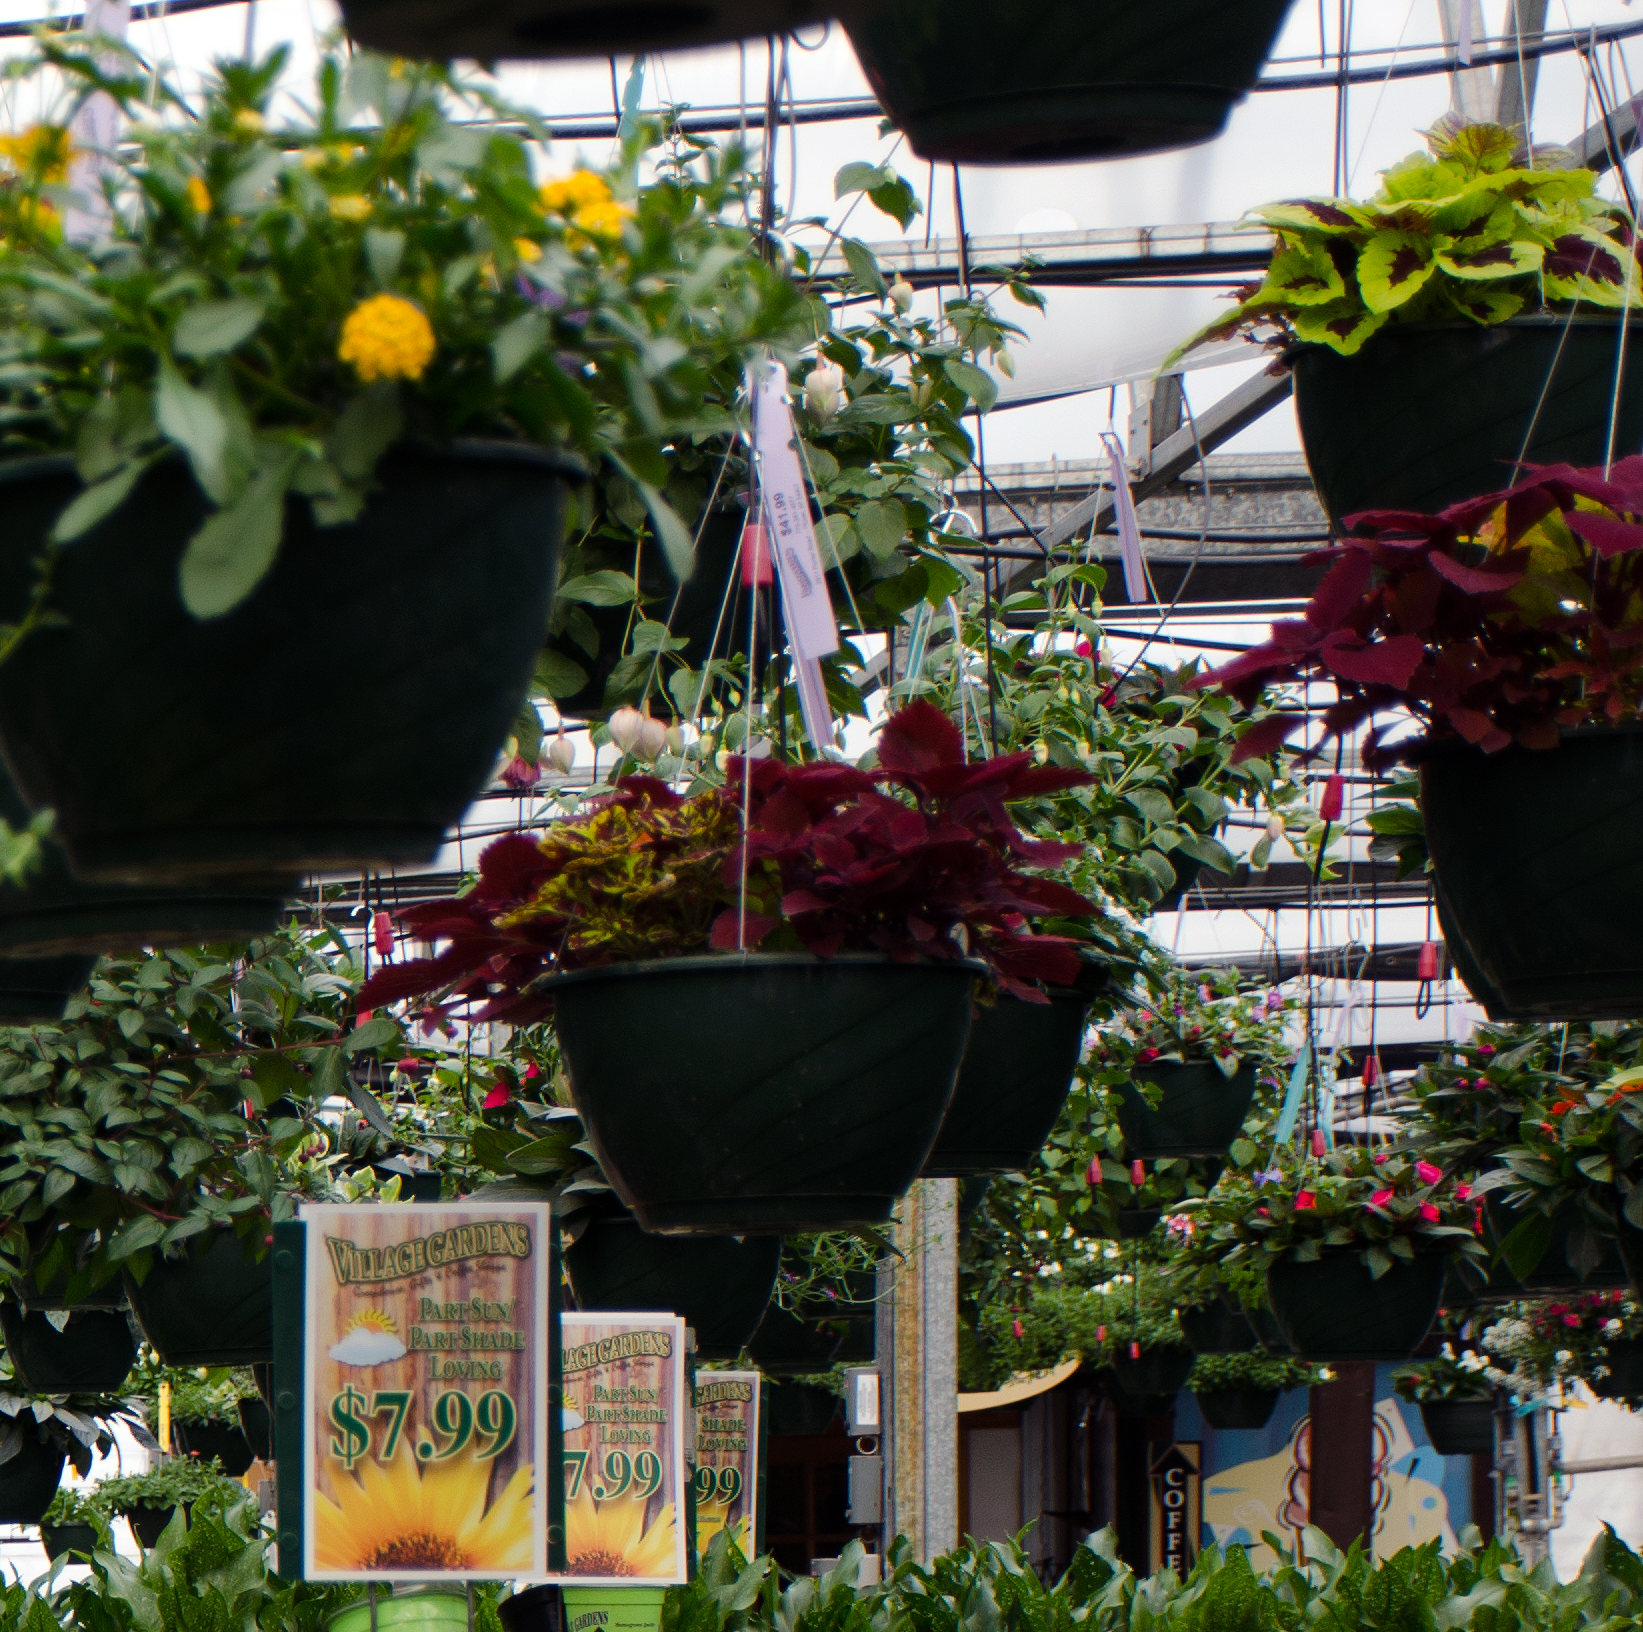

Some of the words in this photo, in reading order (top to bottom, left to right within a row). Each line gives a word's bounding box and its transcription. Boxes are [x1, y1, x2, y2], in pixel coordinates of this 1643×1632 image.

[325, 1236, 426, 1285] VILLAGE
[426, 1221, 531, 1266] GARDENS
[419, 1297, 466, 1322] PART
[409, 1325, 458, 1350] PART
[461, 1325, 525, 1351] SHADE
[597, 1331, 672, 1363] GARDENS
[428, 1354, 503, 1380] LOVING
[593, 1384, 627, 1402] PART
[329, 1383, 516, 1471] $7.99
[586, 1405, 623, 1424] PART
[622, 1405, 668, 1424] SHADE
[599, 1425, 652, 1444] LOVING
